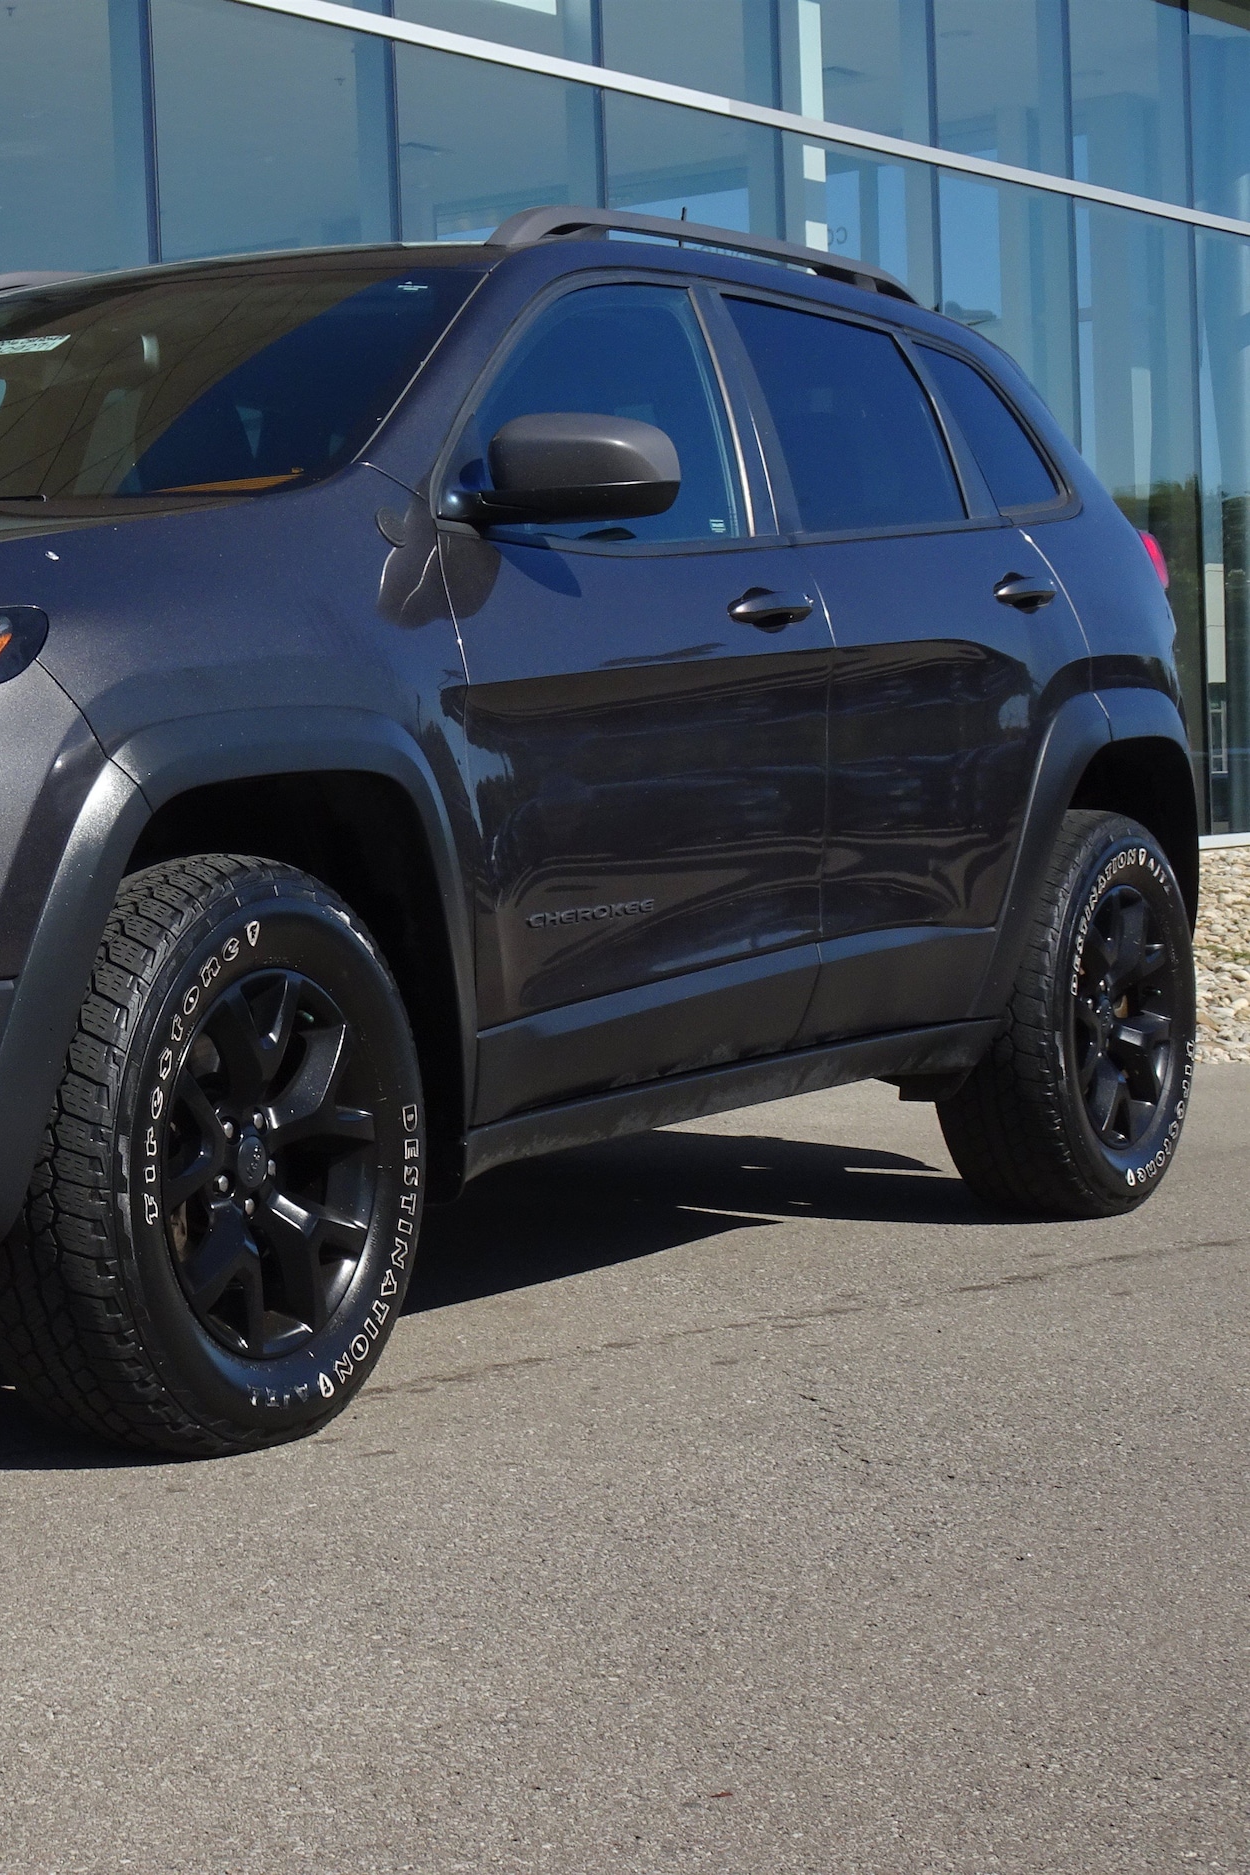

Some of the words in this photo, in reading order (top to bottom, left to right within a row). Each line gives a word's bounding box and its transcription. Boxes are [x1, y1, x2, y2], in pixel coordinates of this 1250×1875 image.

[526, 898, 655, 929] CHEROKEE
[1071, 847, 1138, 996] DESTINATION
[334, 1103, 419, 1386] DESTINATION
